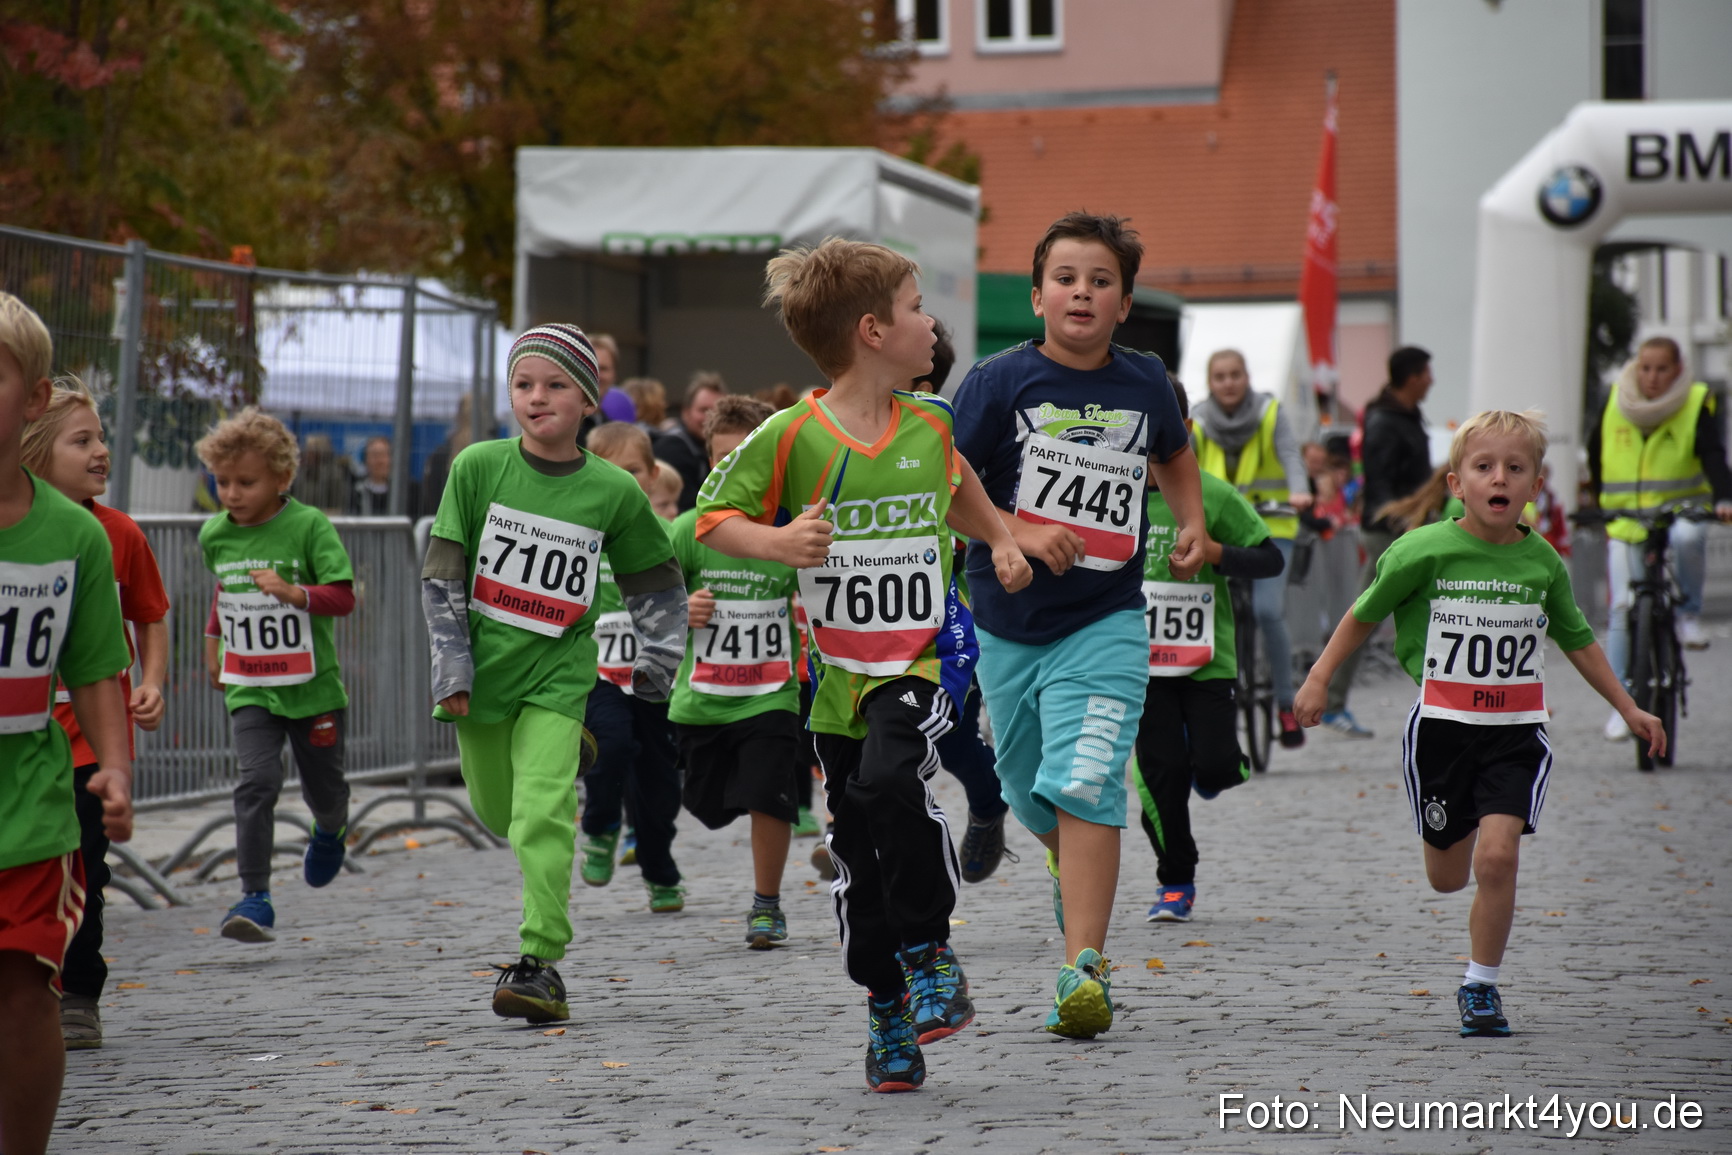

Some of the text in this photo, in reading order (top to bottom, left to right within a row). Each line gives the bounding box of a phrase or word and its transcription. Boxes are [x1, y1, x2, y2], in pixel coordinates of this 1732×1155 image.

[1040, 402, 1124, 421] Down Town
[1029, 445, 1130, 477] PARTL Neumarkt
[1034, 465, 1133, 527] 7443
[488, 514, 586, 550] PARTL Neumarkt
[492, 534, 588, 597] 7108
[819, 552, 919, 568] RTL Neumarkt
[700, 569, 766, 582] Neumarkter
[0, 583, 49, 599] markt
[1436, 578, 1522, 594] Neumarkter
[493, 589, 565, 622] Jonathan
[814, 571, 932, 625] 7600
[1150, 592, 1198, 603] Neumarkt
[240, 602, 291, 613] Neumarkt
[727, 610, 775, 620] Neumarkt
[1432, 611, 1533, 628] PARTL Neumarkt
[0, 606, 55, 668] 16
[224, 614, 301, 651] 7160
[705, 622, 783, 659] 7419
[600, 633, 637, 663] 70
[1440, 631, 1537, 678] 7092
[238, 659, 288, 673] Mariano
[712, 665, 763, 683] ROBIN
[1473, 690, 1505, 708] Phil
